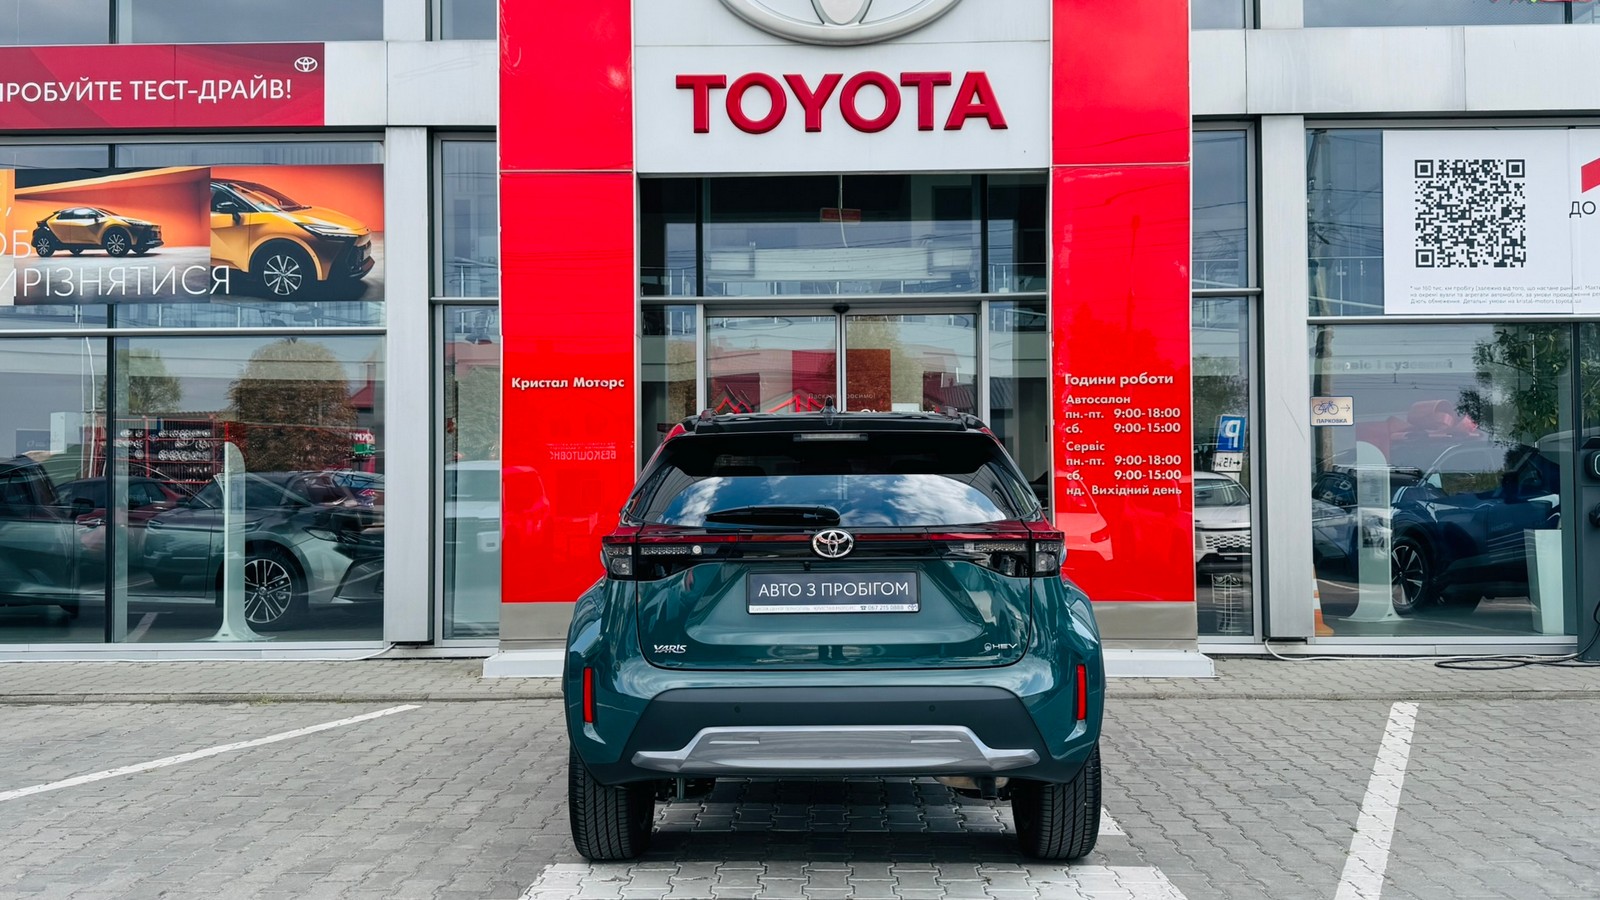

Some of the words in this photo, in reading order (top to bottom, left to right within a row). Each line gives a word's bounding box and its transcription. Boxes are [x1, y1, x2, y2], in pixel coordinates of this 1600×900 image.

[0, 77, 122, 103] РОБУЙТЕ
[129, 75, 292, 104] ТЕСТ-ДРАЙВ!
[675, 71, 1009, 134] TOYOTA
[1569, 200, 1597, 218] ДО
[0, 229, 31, 259] Б
[511, 377, 569, 391] Кристал
[573, 376, 625, 390] Моторс
[1064, 373, 1116, 387] Години
[1119, 371, 1174, 388] роботи
[1065, 394, 1131, 404] Автосалон
[1065, 411, 1105, 419] пн.-пт.
[1113, 407, 1181, 418] 9:00-18:00
[1065, 423, 1083, 434] сб.
[1113, 422, 1181, 433] 9:00-15:00
[1065, 440, 1105, 453] Сервіс
[1065, 457, 1106, 466] пн.-пт.
[1114, 454, 1182, 465] 9:00-18:00
[1066, 469, 1084, 481] сб.
[1114, 469, 1182, 480] 9:00-15:00
[1066, 487, 1085, 496] нд.
[1091, 484, 1150, 496] Вихідний
[1152, 487, 1182, 496] день
[758, 583, 802, 597] АВТО
[821, 582, 909, 597] ПРОБІГОМ
[653, 644, 688, 654] YARIS
